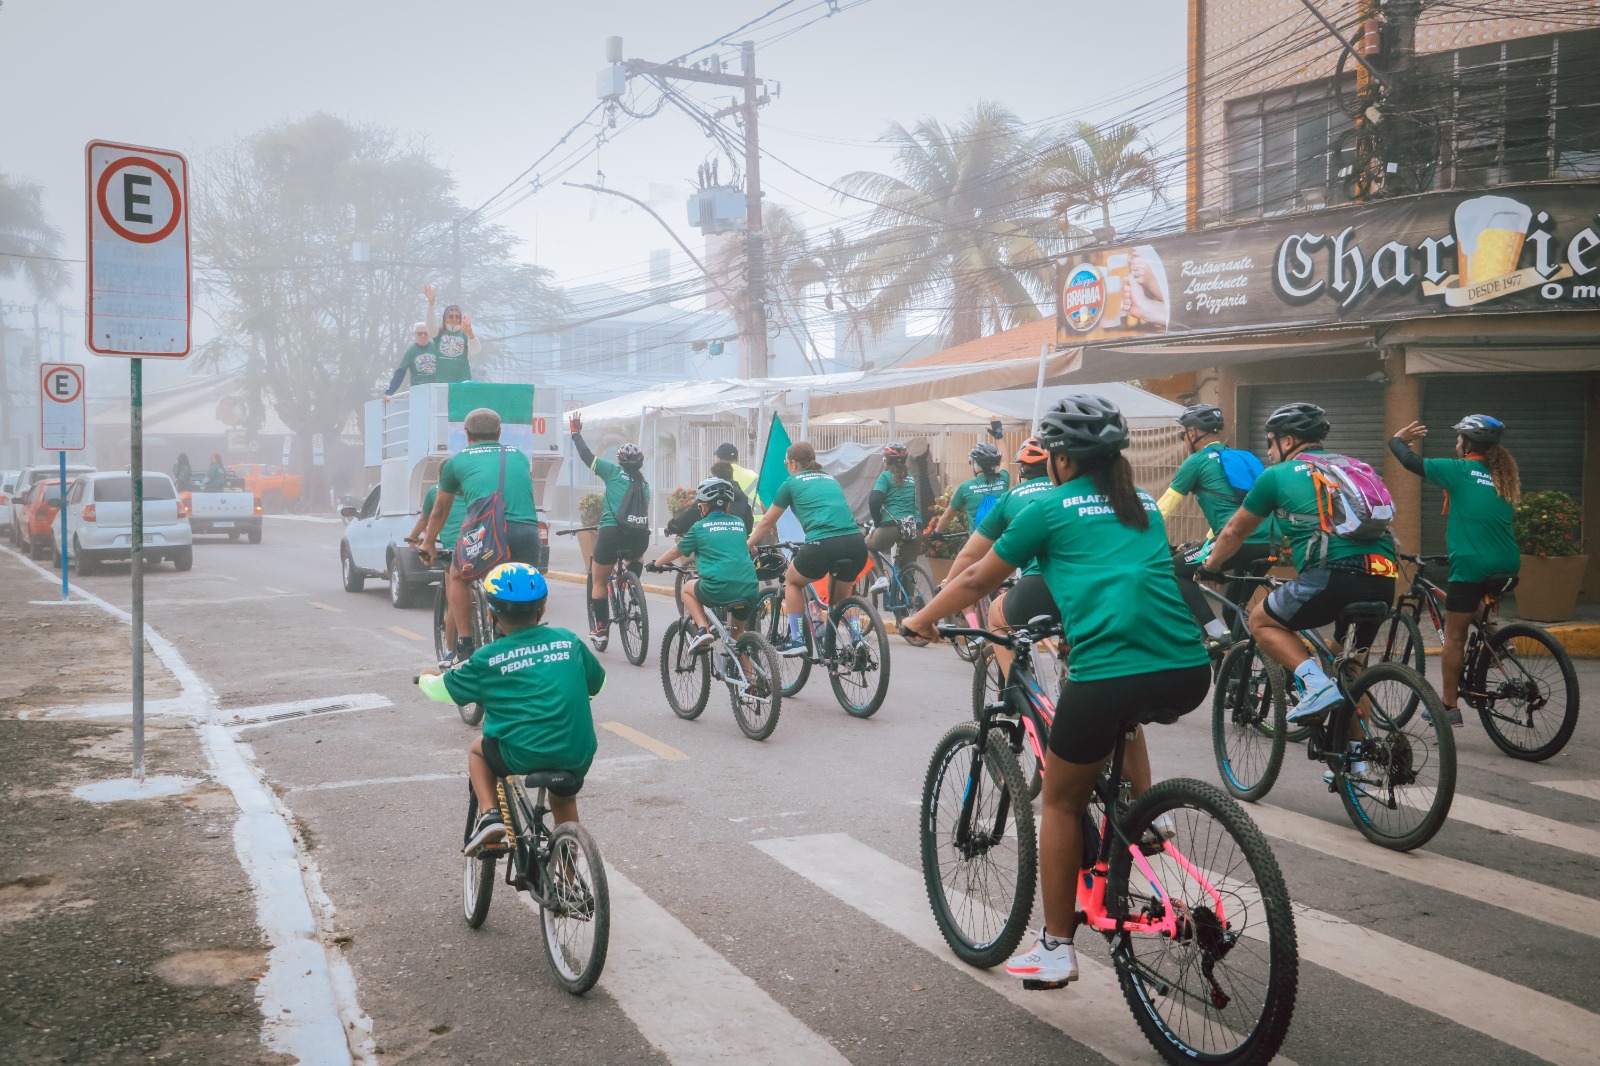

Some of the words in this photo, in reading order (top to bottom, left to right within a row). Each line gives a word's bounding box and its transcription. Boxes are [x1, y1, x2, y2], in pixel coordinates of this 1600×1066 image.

[124, 173, 153, 224] E
[1181, 256, 1254, 277] Restaurante,
[1183, 274, 1248, 294] Lanchonete
[1468, 280, 1501, 300] DESDE
[1503, 274, 1522, 290] 1977
[1541, 283, 1563, 299] O
[1572, 285, 1600, 298] m
[1067, 286, 1100, 309] BRAHMA
[1186, 301, 1192, 311] e
[1196, 293, 1248, 314] Pizzaria
[55, 375, 69, 395] E
[1142, 502, 1157, 511] 25
[628, 515, 648, 524] SPORT
[489, 644, 549, 667] BELAITALIA
[550, 640, 573, 650] FEST
[501, 658, 535, 675] PEDAL
[543, 651, 570, 664] 2025
